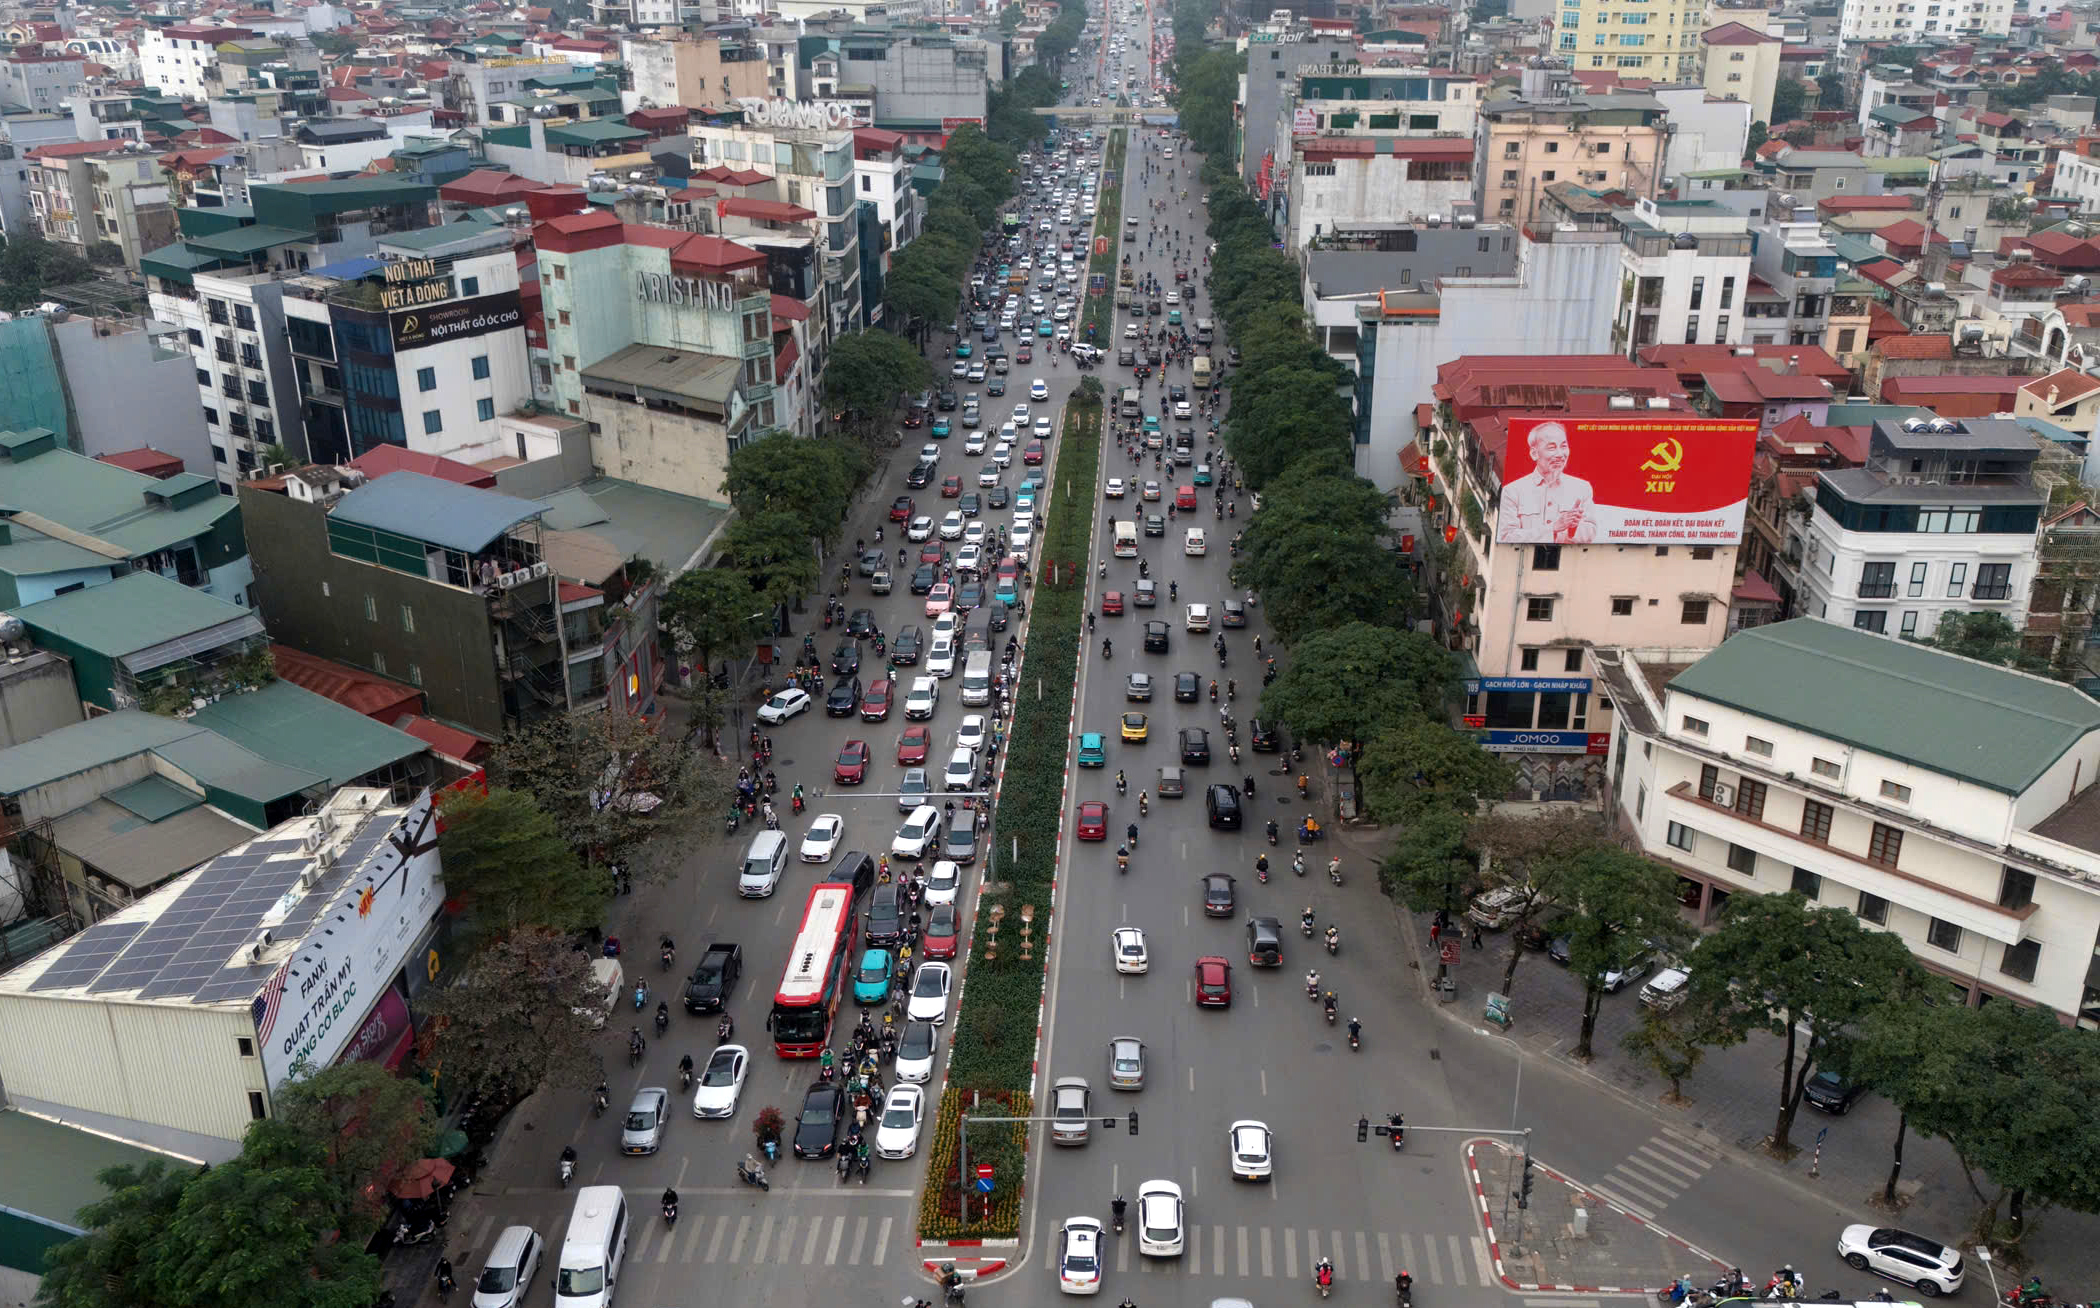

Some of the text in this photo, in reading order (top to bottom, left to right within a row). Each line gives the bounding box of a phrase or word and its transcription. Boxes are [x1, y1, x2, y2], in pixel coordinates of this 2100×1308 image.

[1277, 32, 1305, 46] golf
[416, 281, 448, 303] ĐÔNG
[636, 271, 735, 313] ARISTINO
[429, 307, 470, 321] SHOWROOM
[430, 324, 448, 338] NỘI
[449, 319, 471, 333] THẤT
[472, 315, 486, 328] GỖ
[1645, 481, 1675, 493] XIV
[1608, 529, 1628, 538] THÀNH
[1648, 529, 1667, 538] THÀNH
[1699, 530, 1718, 538] THÀNH
[1510, 734, 1560, 744] JOMOO
[300, 957, 328, 999] FANXi
[284, 955, 352, 1056] QUẠT TRẦN MỸ
[288, 981, 357, 1080] ĐỘNG CƠ BLDC
[361, 1011, 382, 1043] Store
